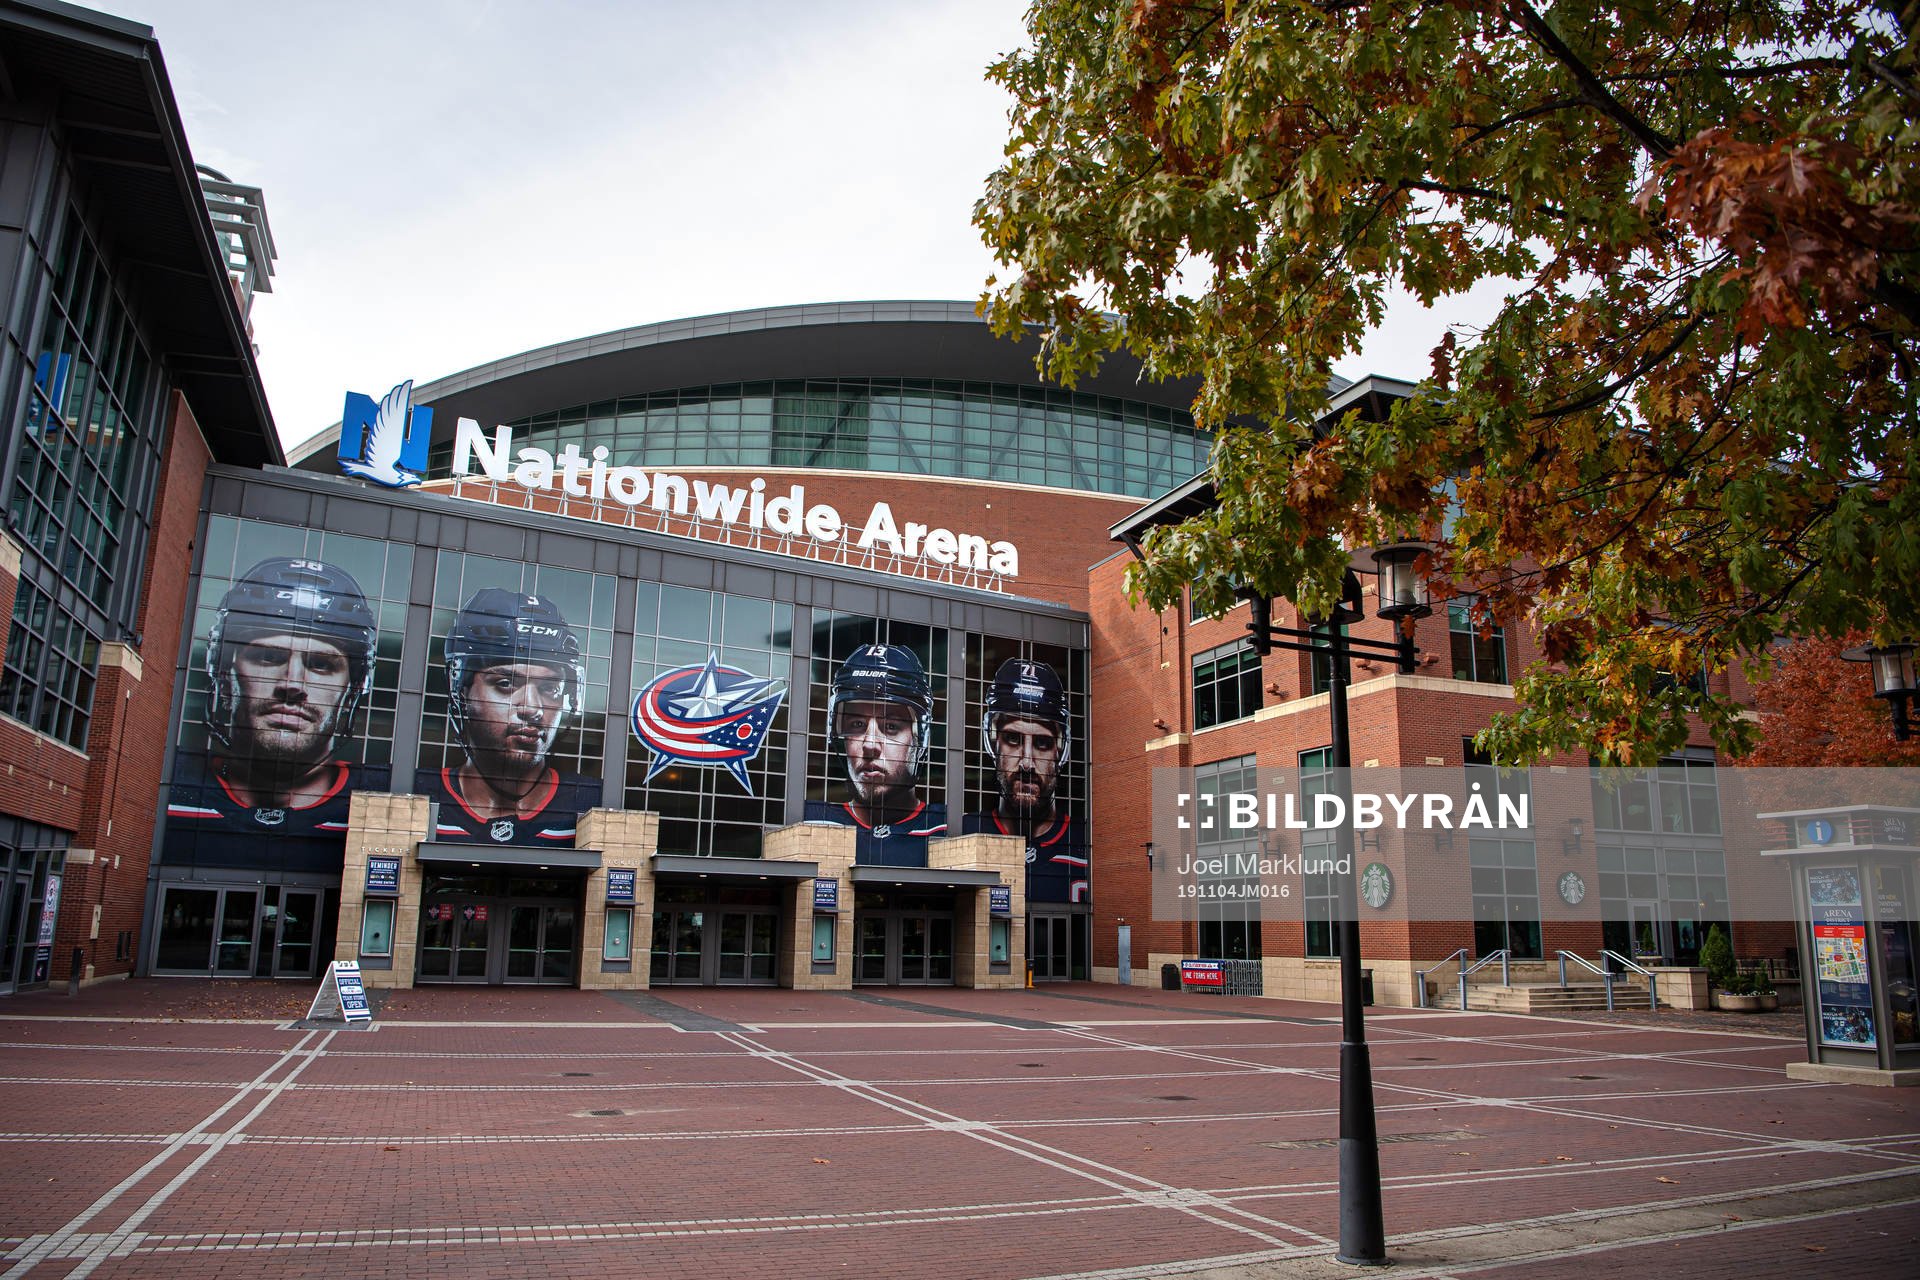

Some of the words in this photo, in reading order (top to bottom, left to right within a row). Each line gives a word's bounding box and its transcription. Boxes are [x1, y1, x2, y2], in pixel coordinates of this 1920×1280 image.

[452, 417, 841, 541] Nationwide
[857, 501, 1018, 577] Arena
[517, 623, 558, 637] CCM
[866, 645, 887, 656] 13
[1021, 664, 1036, 677] 71
[370, 861, 398, 870] REMINDER
[610, 873, 634, 881] REMINDER
[1823, 909, 1852, 919] ARENA
[1206, 972, 1219, 980] HERE
